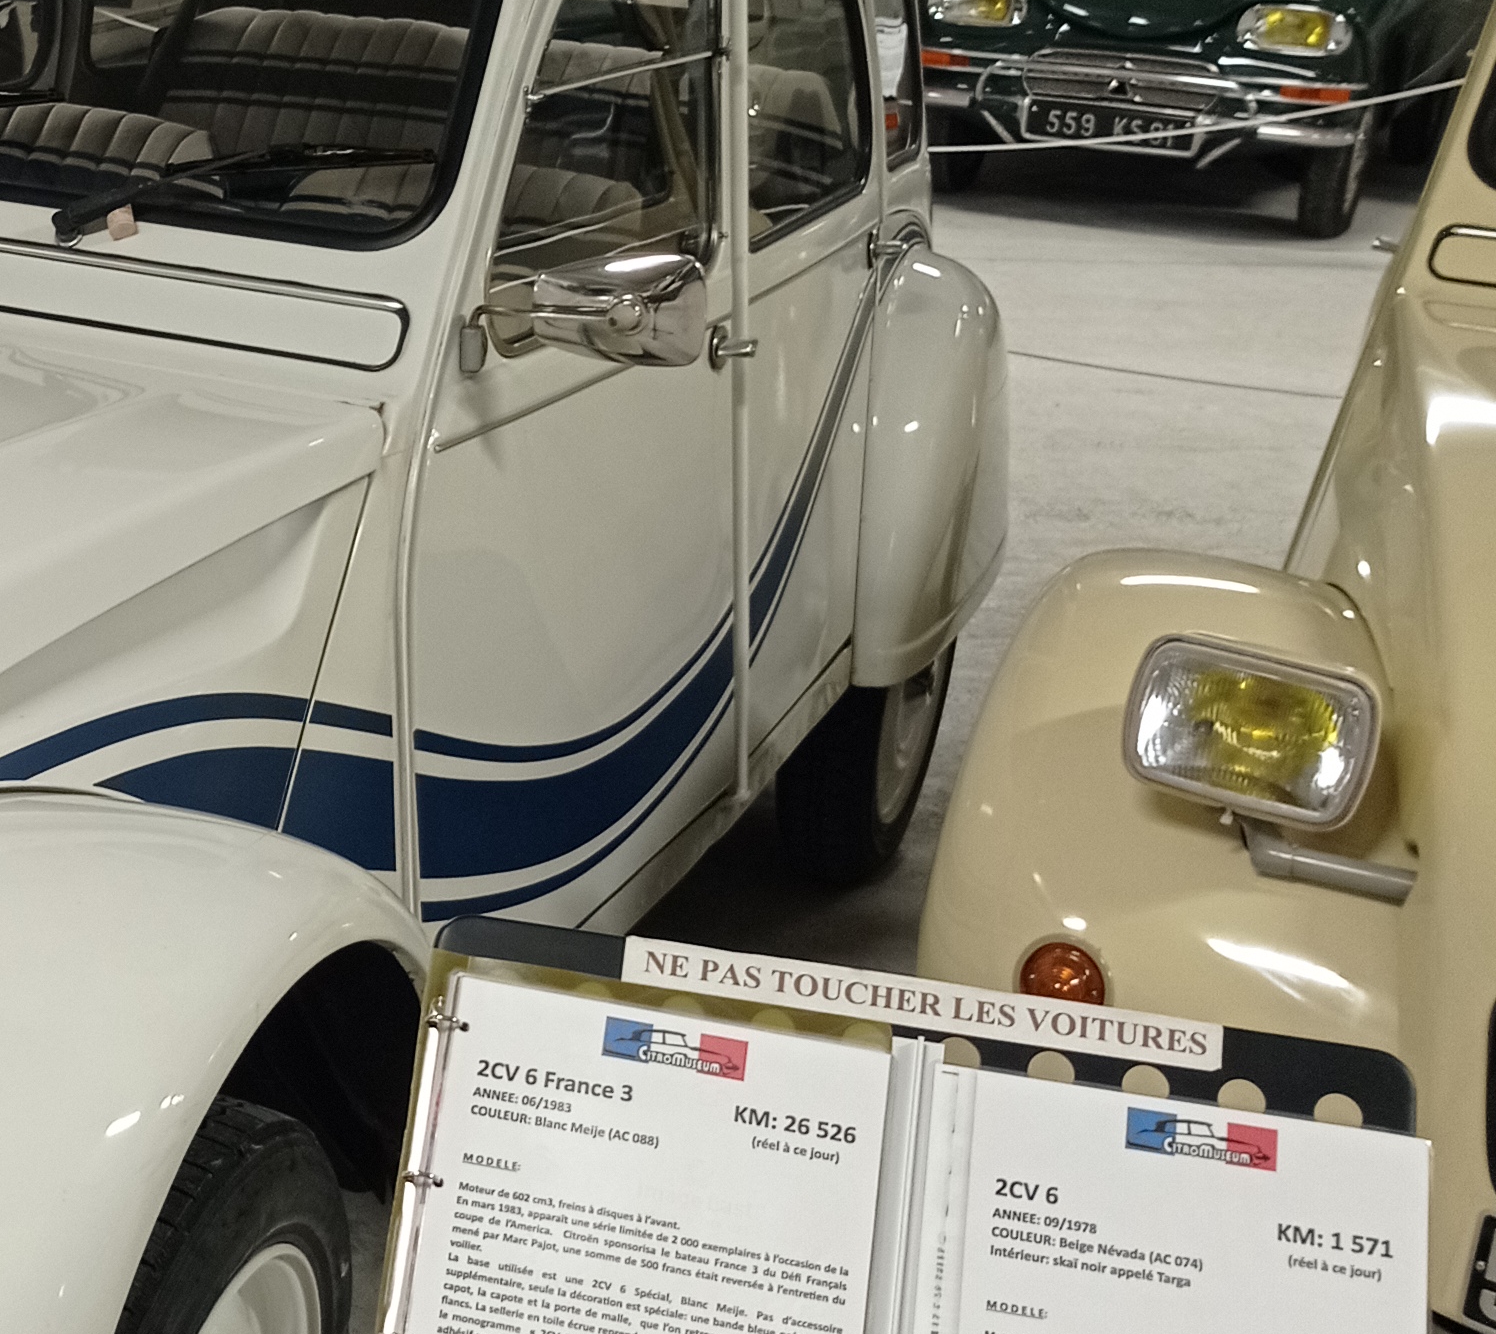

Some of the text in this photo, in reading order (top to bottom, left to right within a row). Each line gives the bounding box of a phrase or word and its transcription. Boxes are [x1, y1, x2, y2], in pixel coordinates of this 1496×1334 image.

[1045, 109, 1096, 137] 559
[644, 950, 1209, 1057] NE PAS TOUCHER LES VOITURES
[476, 1059, 634, 1102] 2CV 6 France 3
[472, 1086, 572, 1113] ANNEE: 06/1983
[470, 1104, 660, 1150] COULEUR: Blanc Meije (AC 088)
[733, 1105, 857, 1144] KM: 26 526
[751, 1135, 840, 1165] (réel à ce jour)
[995, 1178, 1059, 1205] 2CV 6
[992, 1207, 1097, 1235] ANNEE: 09/1978
[991, 1226, 1204, 1273] COULEUR: Beige Névada (AC 074)
[1277, 1223, 1394, 1259] KM: 1 571
[989, 1244, 1191, 1289] Intérieur: skaï noir appelé Targa
[1287, 1254, 1382, 1283] (réel à ce jour)
